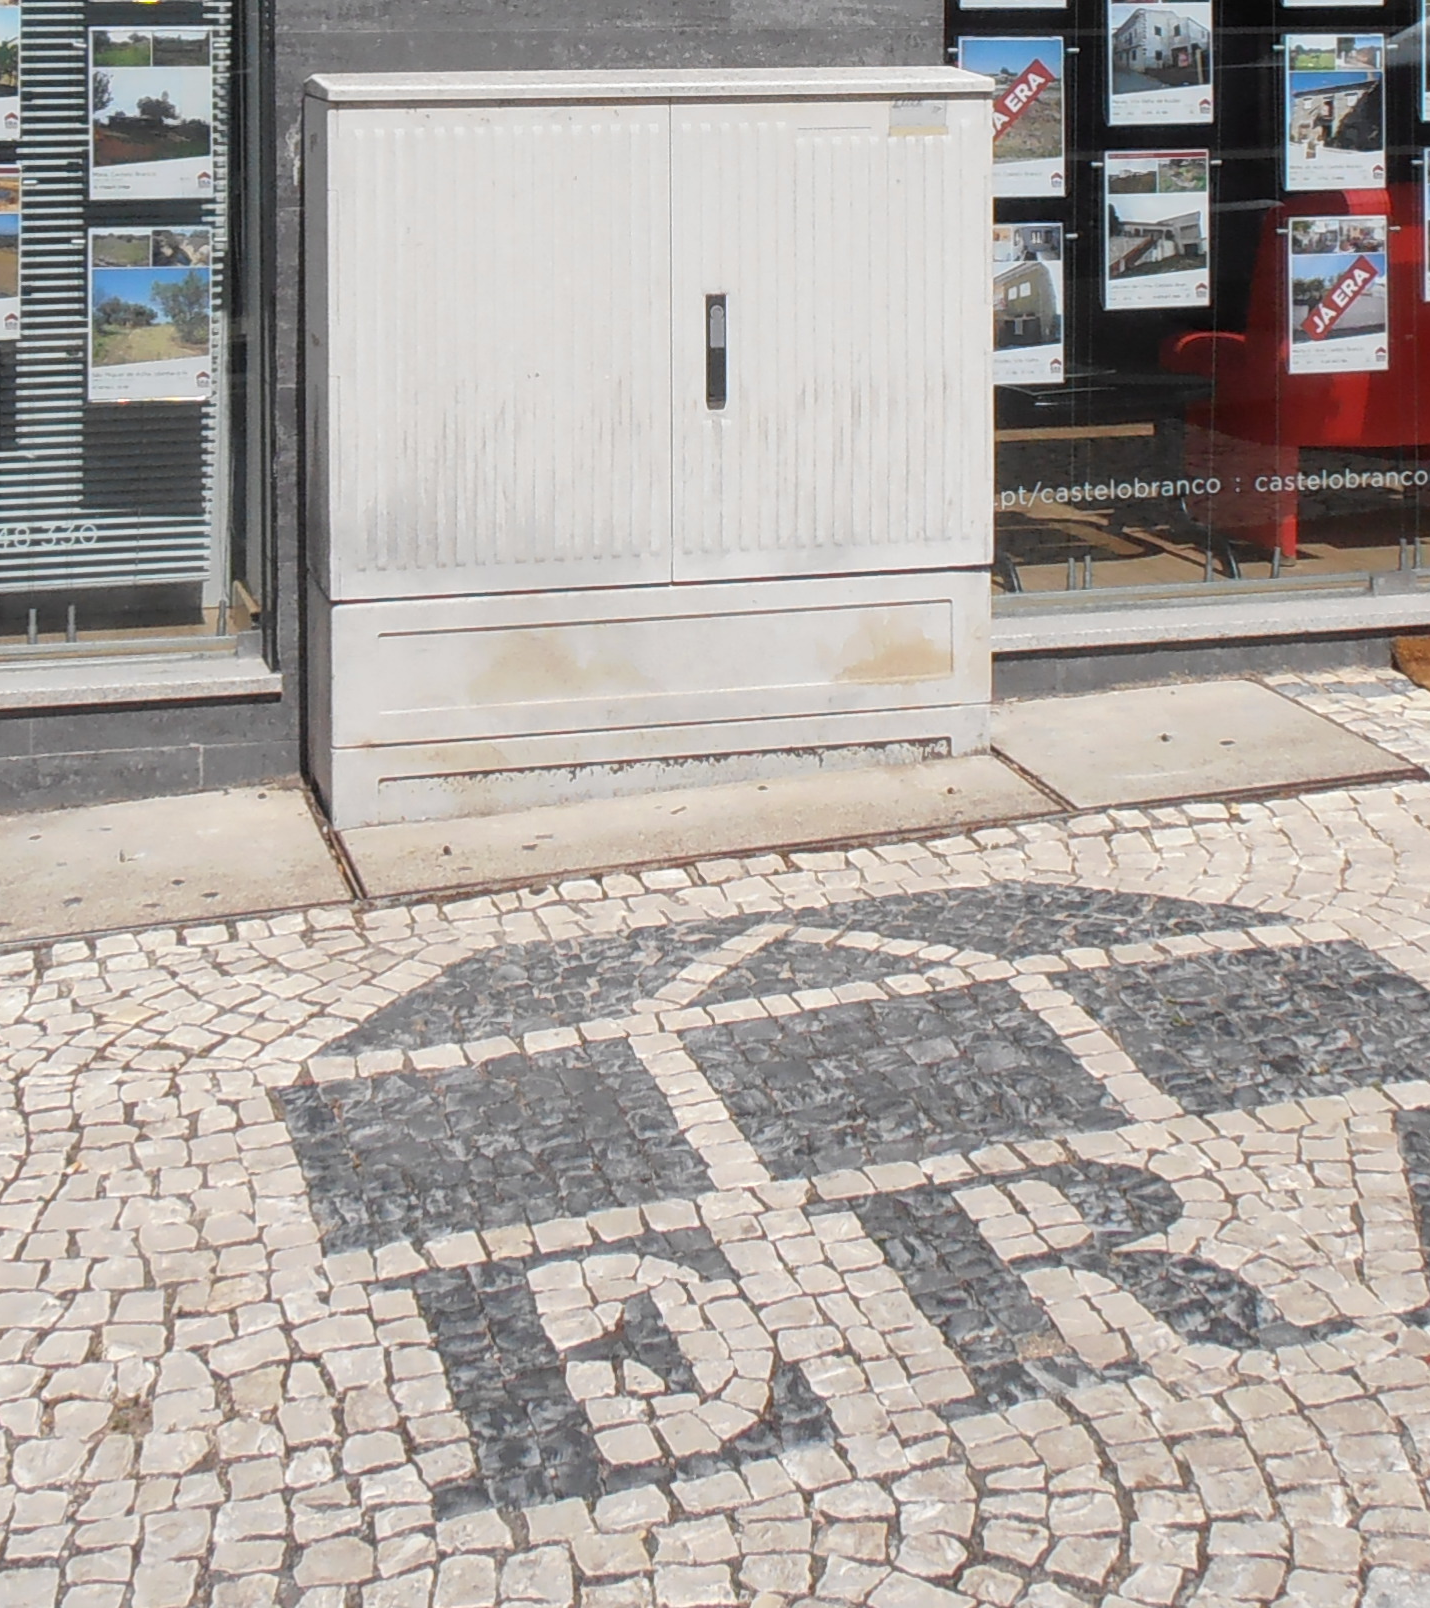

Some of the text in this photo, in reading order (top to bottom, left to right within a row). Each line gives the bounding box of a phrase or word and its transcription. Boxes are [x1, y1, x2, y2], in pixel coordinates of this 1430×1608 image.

[1004, 73, 1046, 113] ERA
[1313, 269, 1370, 333] JÁ ERA
[993, 476, 1221, 509] .pt/castelobranco
